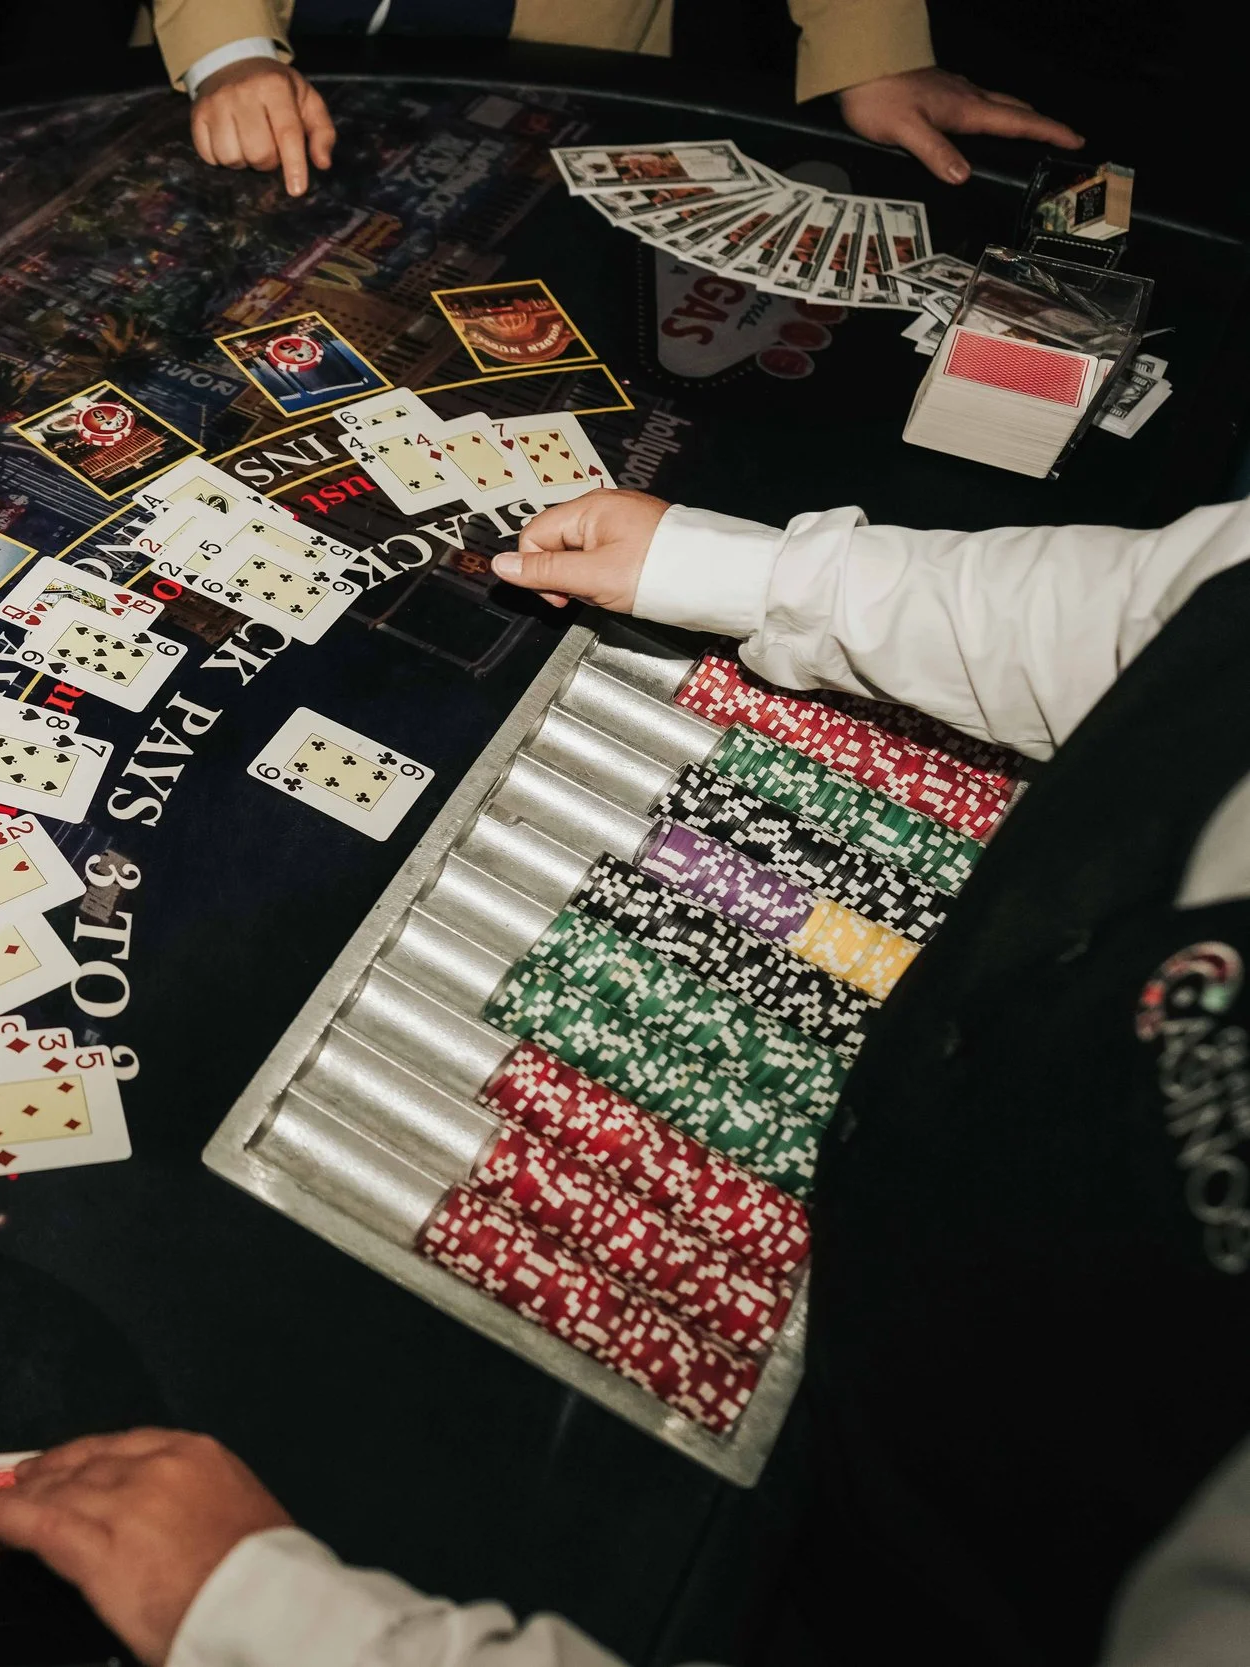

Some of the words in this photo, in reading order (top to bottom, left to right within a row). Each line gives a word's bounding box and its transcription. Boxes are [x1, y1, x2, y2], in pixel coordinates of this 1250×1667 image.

[661, 275, 747, 345] GAS
[340, 411, 357, 425] 6
[492, 423, 505, 437] 7
[349, 437, 366, 450] 4
[417, 432, 433, 446] 4
[617, 409, 693, 489] hollywo
[142, 494, 163, 508] A
[300, 474, 377, 515] ust
[139, 538, 163, 553] 2
[199, 539, 222, 555] 5
[329, 545, 352, 559] 5
[159, 561, 183, 577] 2
[201, 578, 224, 593] 6
[332, 580, 355, 596] 6
[2, 605, 30, 620] Q
[129, 599, 157, 615] Q
[156, 641, 180, 656] 9
[21, 650, 45, 665] 9
[45, 716, 70, 730] 8
[81, 742, 107, 758] 7
[106, 690, 224, 828] PAYS
[256, 763, 281, 780] 6
[400, 763, 425, 780] 6
[6, 820, 35, 840] 2
[83, 853, 142, 891] 3
[70, 910, 134, 1019] TO
[38, 1034, 67, 1051] 3
[75, 1052, 105, 1069] 5
